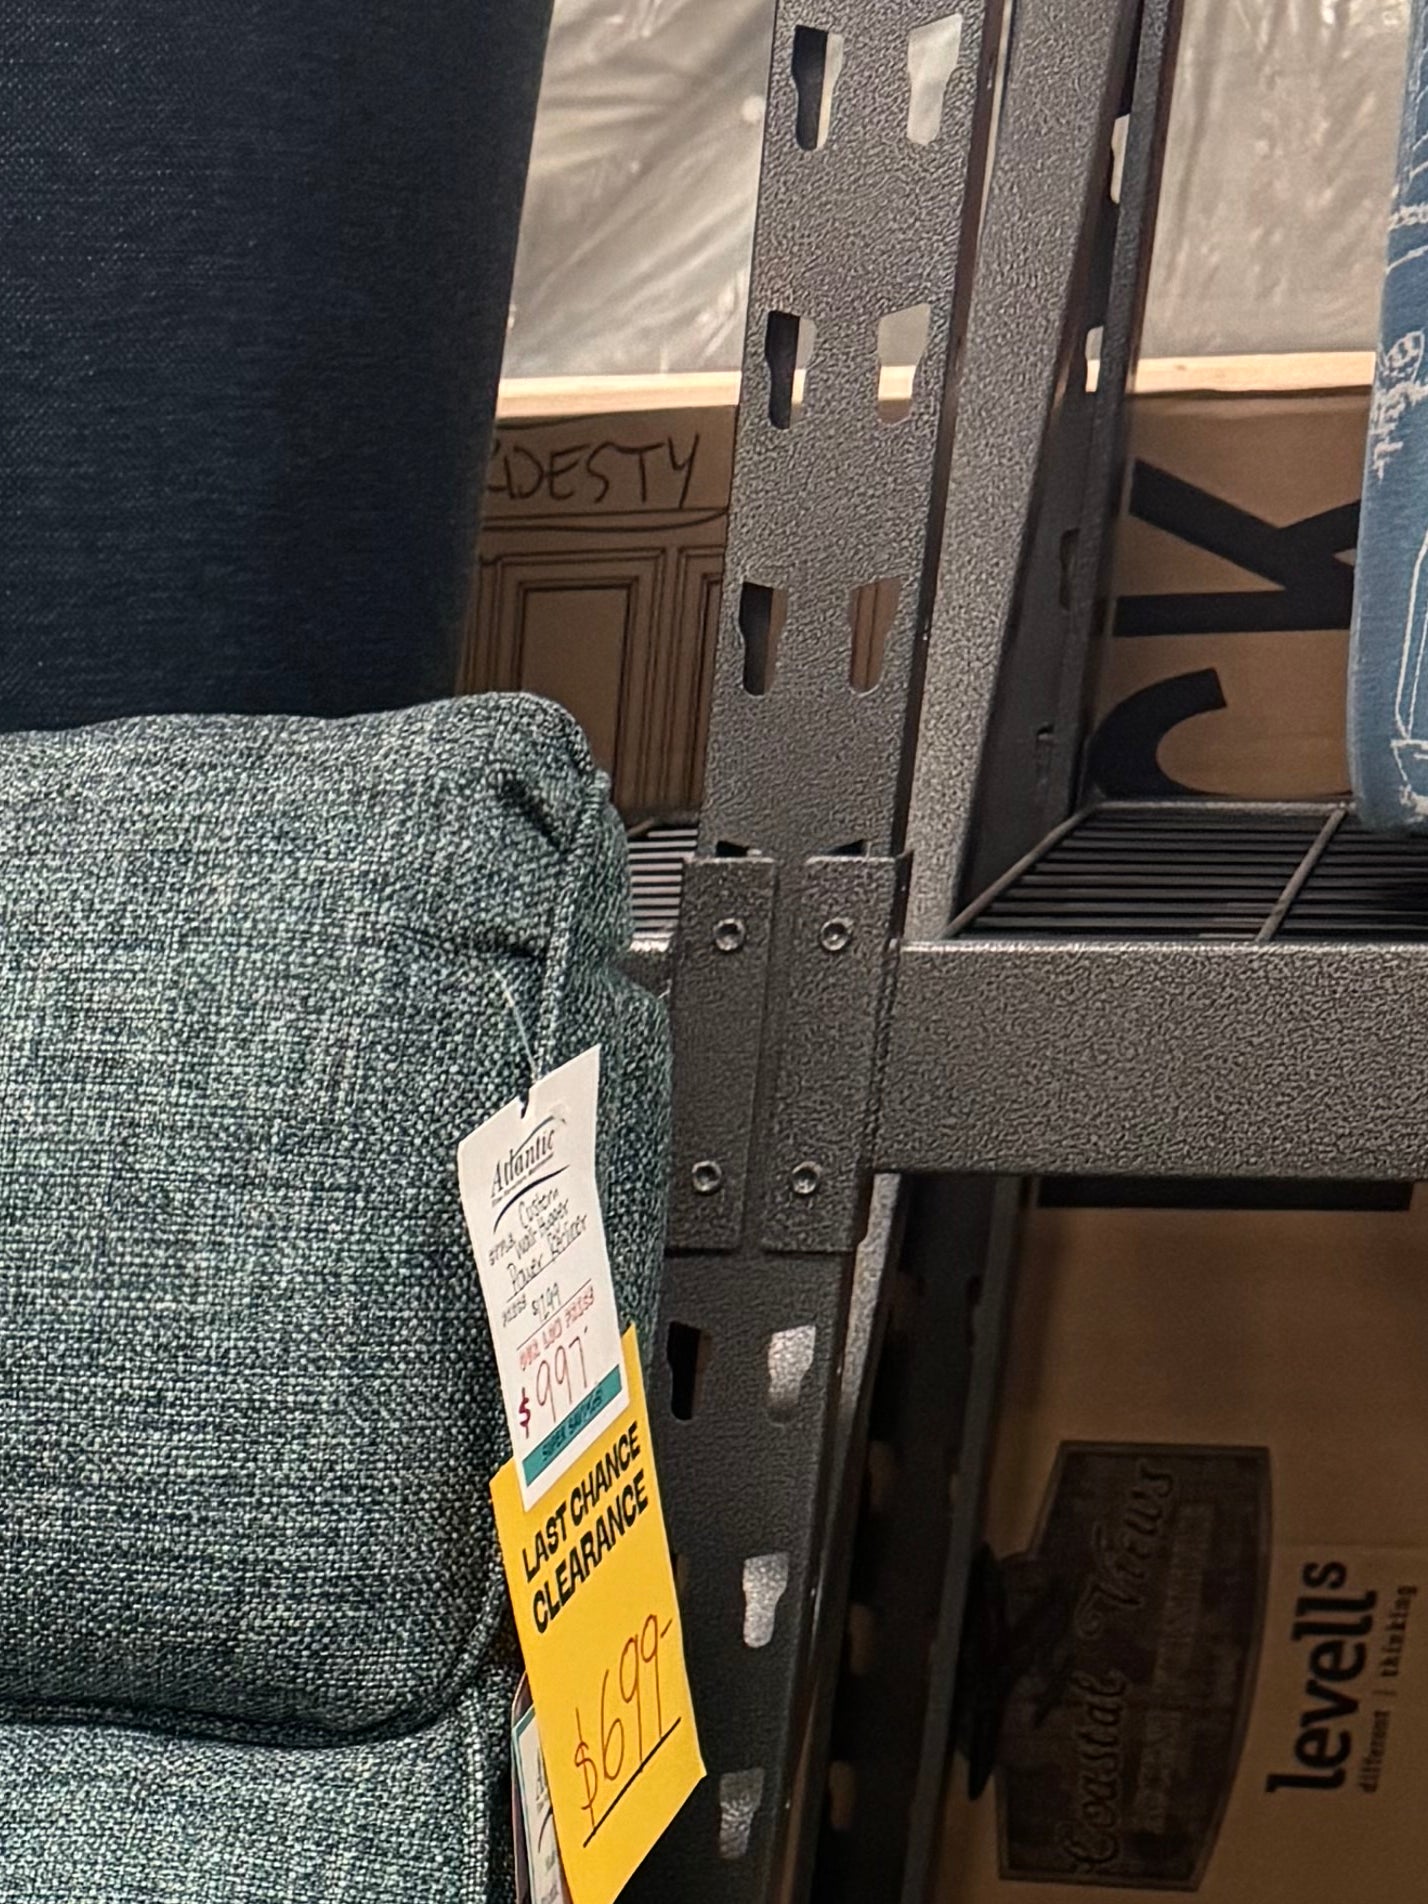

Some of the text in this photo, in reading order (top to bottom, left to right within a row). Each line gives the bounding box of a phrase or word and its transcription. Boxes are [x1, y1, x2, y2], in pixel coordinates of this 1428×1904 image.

[487, 433, 701, 509] DESTY
[490, 1129, 555, 1199] Atlantic
[506, 1253, 544, 1295] Power
[522, 1420, 641, 1584] LAST CHANCE
[532, 1468, 649, 1634] CLEARANCE
[1075, 1461, 1178, 1640] Views
[1264, 1560, 1378, 1794] levells
[1357, 1584, 1419, 1793] different thinking
[1060, 1669, 1130, 1874] Coastal
